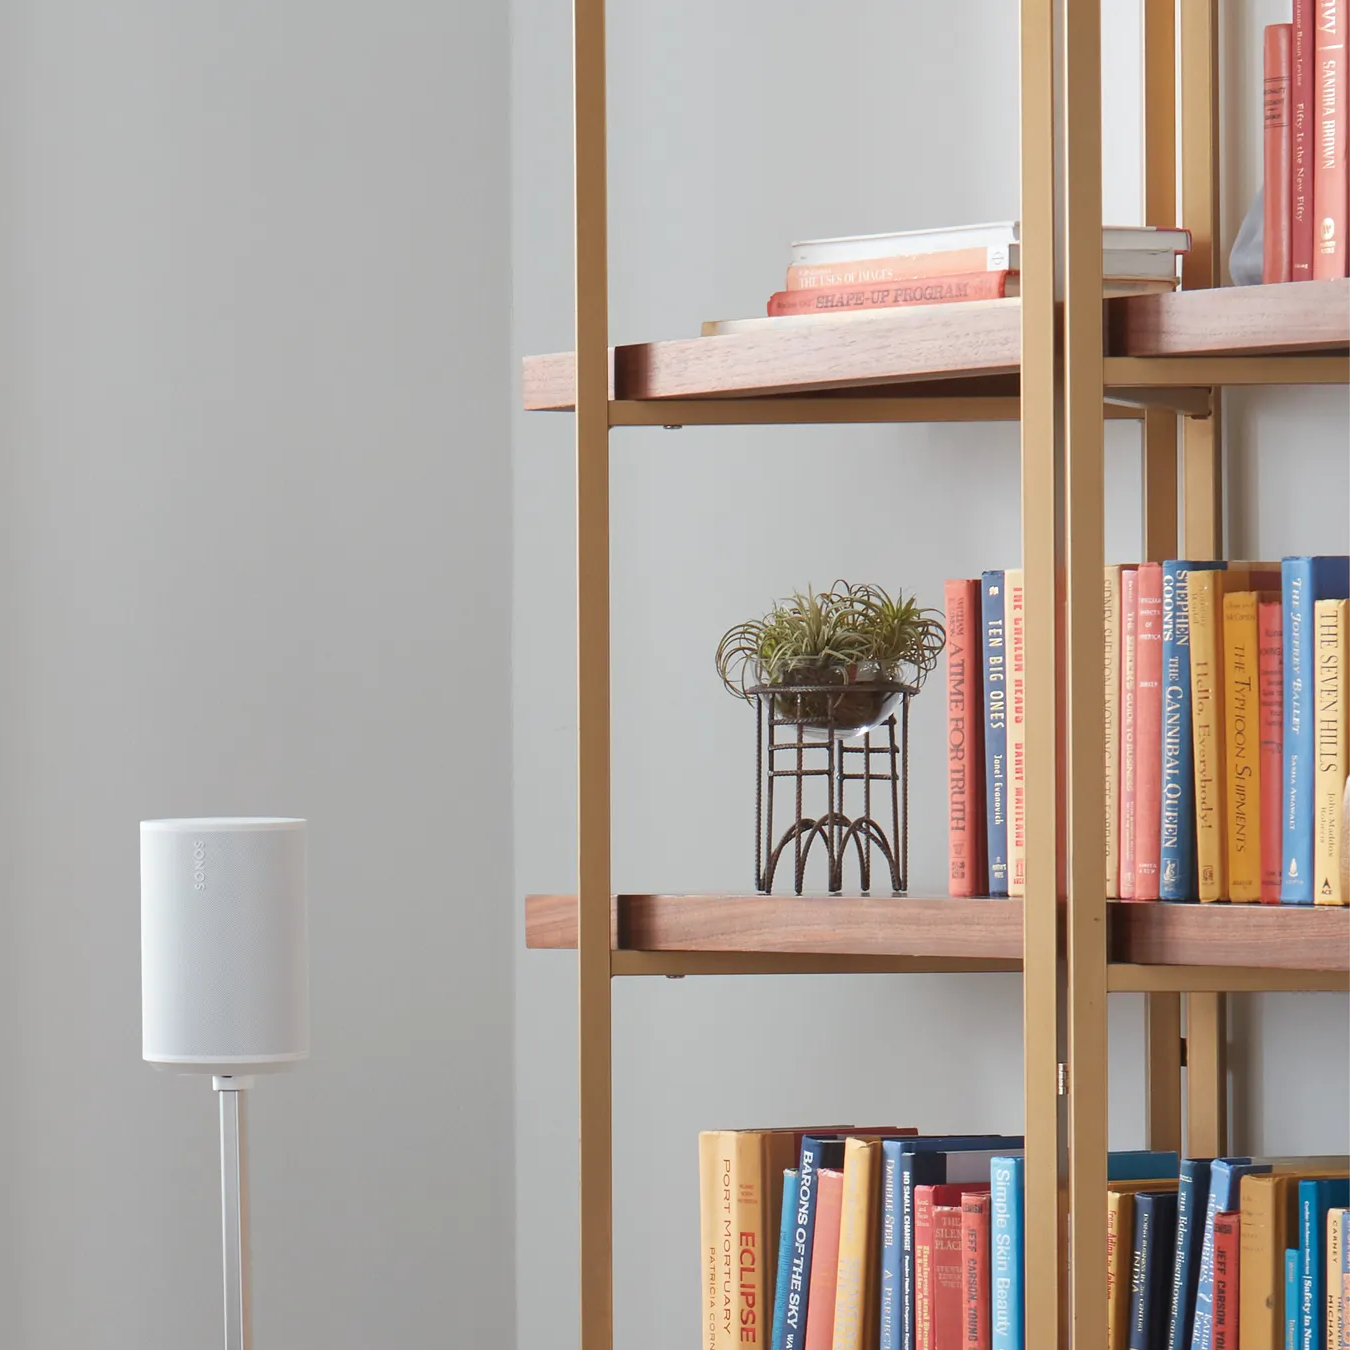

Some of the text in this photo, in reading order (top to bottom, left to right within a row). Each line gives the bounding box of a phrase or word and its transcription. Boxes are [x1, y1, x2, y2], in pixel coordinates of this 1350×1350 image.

[1295, 31, 1306, 222] Braun Levine Fifty the New Fifty
[1322, 60, 1336, 170] SANDRA BROWN
[815, 289, 891, 310] SHAPE-UP
[893, 281, 970, 304] PROGRAM
[858, 269, 894, 282] IMAGES
[1162, 575, 1175, 643] COONTS
[1175, 571, 1190, 647] STEPHEN
[949, 641, 965, 658] A
[1291, 577, 1303, 737] THE BALLET
[949, 659, 965, 712] TIME
[988, 619, 1005, 729] TEN BIG ONES
[1319, 610, 1339, 774] THE SEVEN HILLS
[1125, 693, 1134, 726] GUIDE
[949, 716, 966, 762] FOR
[1163, 656, 1184, 849] THE CANNIBAL QUEEN
[1195, 660, 1213, 830] Hello, Everybody!
[1234, 645, 1253, 854] THE TYPHOON SHIPMENTS
[993, 754, 1004, 825] Janet Evanovich
[1125, 744, 1134, 793] BUSINESS
[950, 764, 967, 833] TRUTH
[1327, 793, 1337, 858] John Maddox
[193, 840, 207, 892] SONOS
[797, 1150, 814, 1225] BARONS
[884, 1160, 896, 1212] DANIELLE
[903, 1171, 911, 1185] NO
[903, 1186, 911, 1214] SMALL
[993, 1169, 1011, 1228] Simple
[1179, 1191, 1188, 1213] THE
[723, 1159, 732, 1335] PORT MORTUARY
[794, 1228, 806, 1256] OF
[883, 1214, 896, 1249] STEEL
[903, 1215, 911, 1252] CHANGE
[967, 1227, 978, 1252] JEFF
[996, 1233, 1011, 1271] Skin
[790, 1257, 804, 1292] THE
[884, 1269, 894, 1281] A
[967, 1258, 978, 1303] CARSON,
[1131, 1250, 1141, 1293] INDIA
[1171, 1215, 1188, 1319] Eden-Eisenhower
[1216, 1246, 1227, 1275] JEFF
[739, 1231, 756, 1344] ECLIPSE
[787, 1292, 801, 1330] SKY
[922, 1298, 930, 1320] and
[994, 1278, 1010, 1336] Beauty
[1215, 1280, 1226, 1327] CARSON,
[1302, 1279, 1313, 1314] Safety
[968, 1307, 979, 1342] YOUNG
[1303, 1315, 1313, 1326] in
